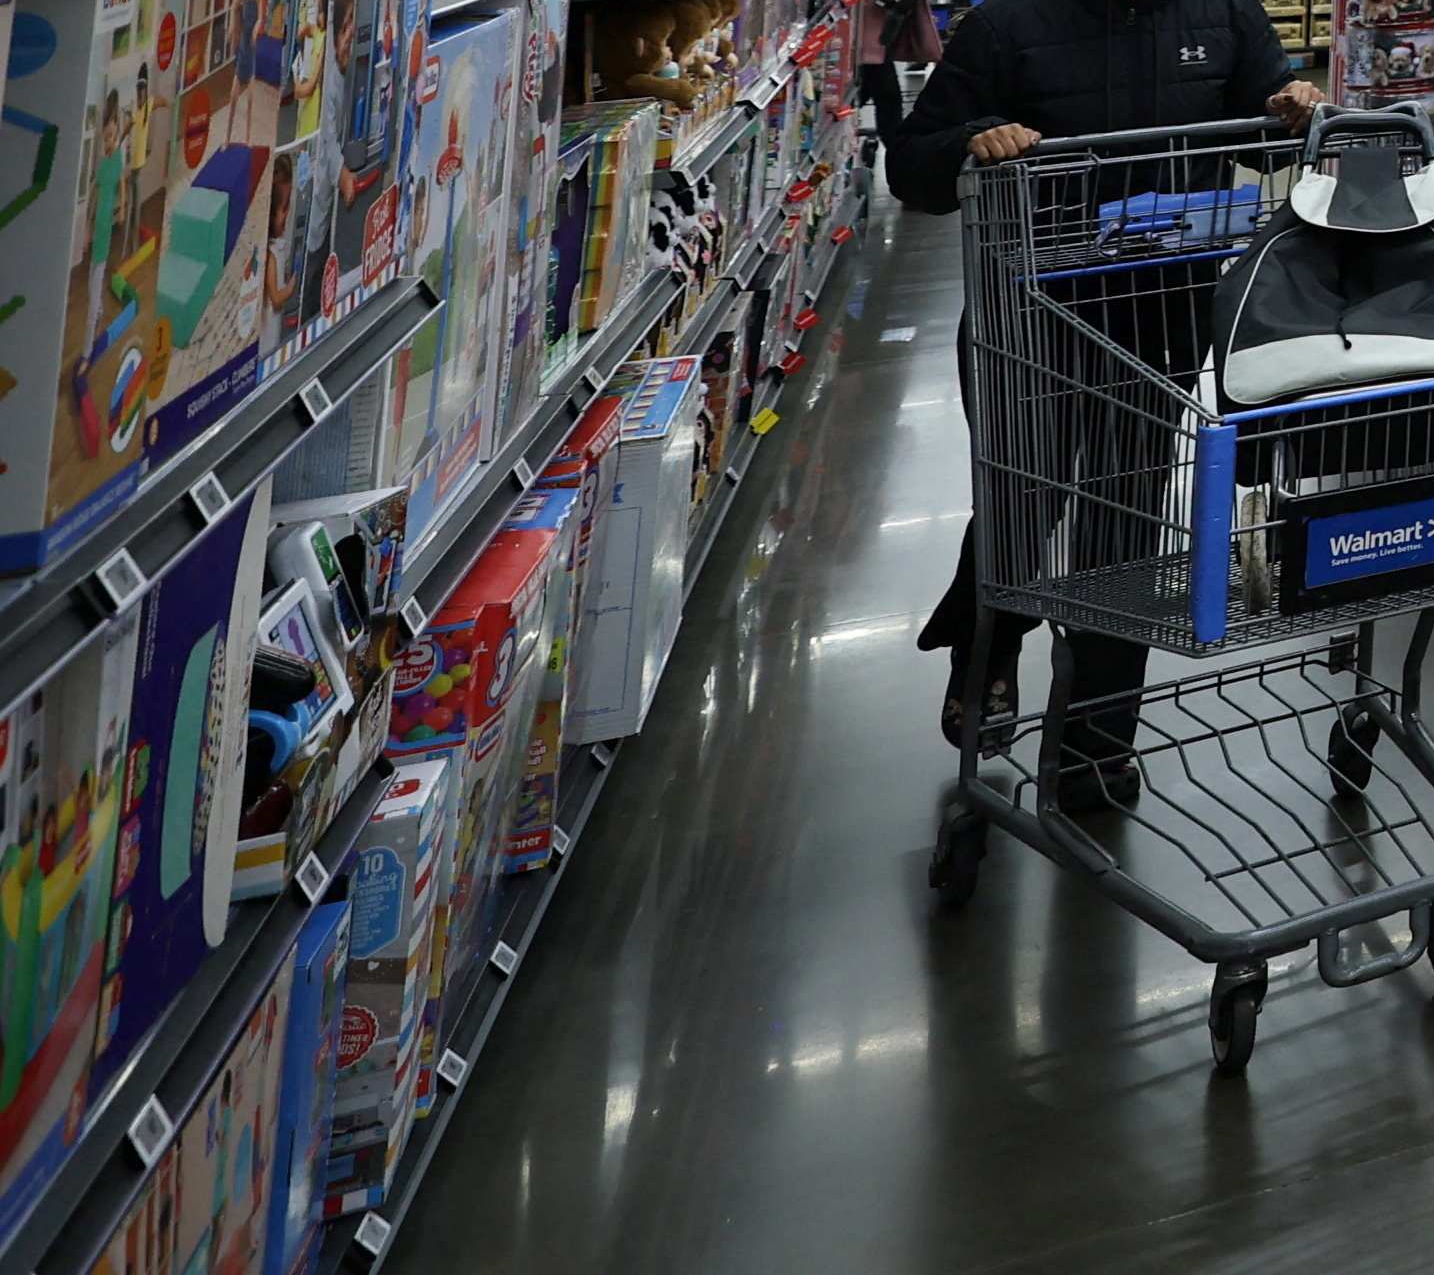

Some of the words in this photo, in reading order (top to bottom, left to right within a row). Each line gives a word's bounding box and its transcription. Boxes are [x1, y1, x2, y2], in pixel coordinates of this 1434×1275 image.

[1329, 520, 1424, 557] Walmart
[1331, 557, 1350, 567] Save
[1350, 552, 1379, 563] money.
[1379, 547, 1397, 557] Live
[1397, 543, 1424, 554] better.
